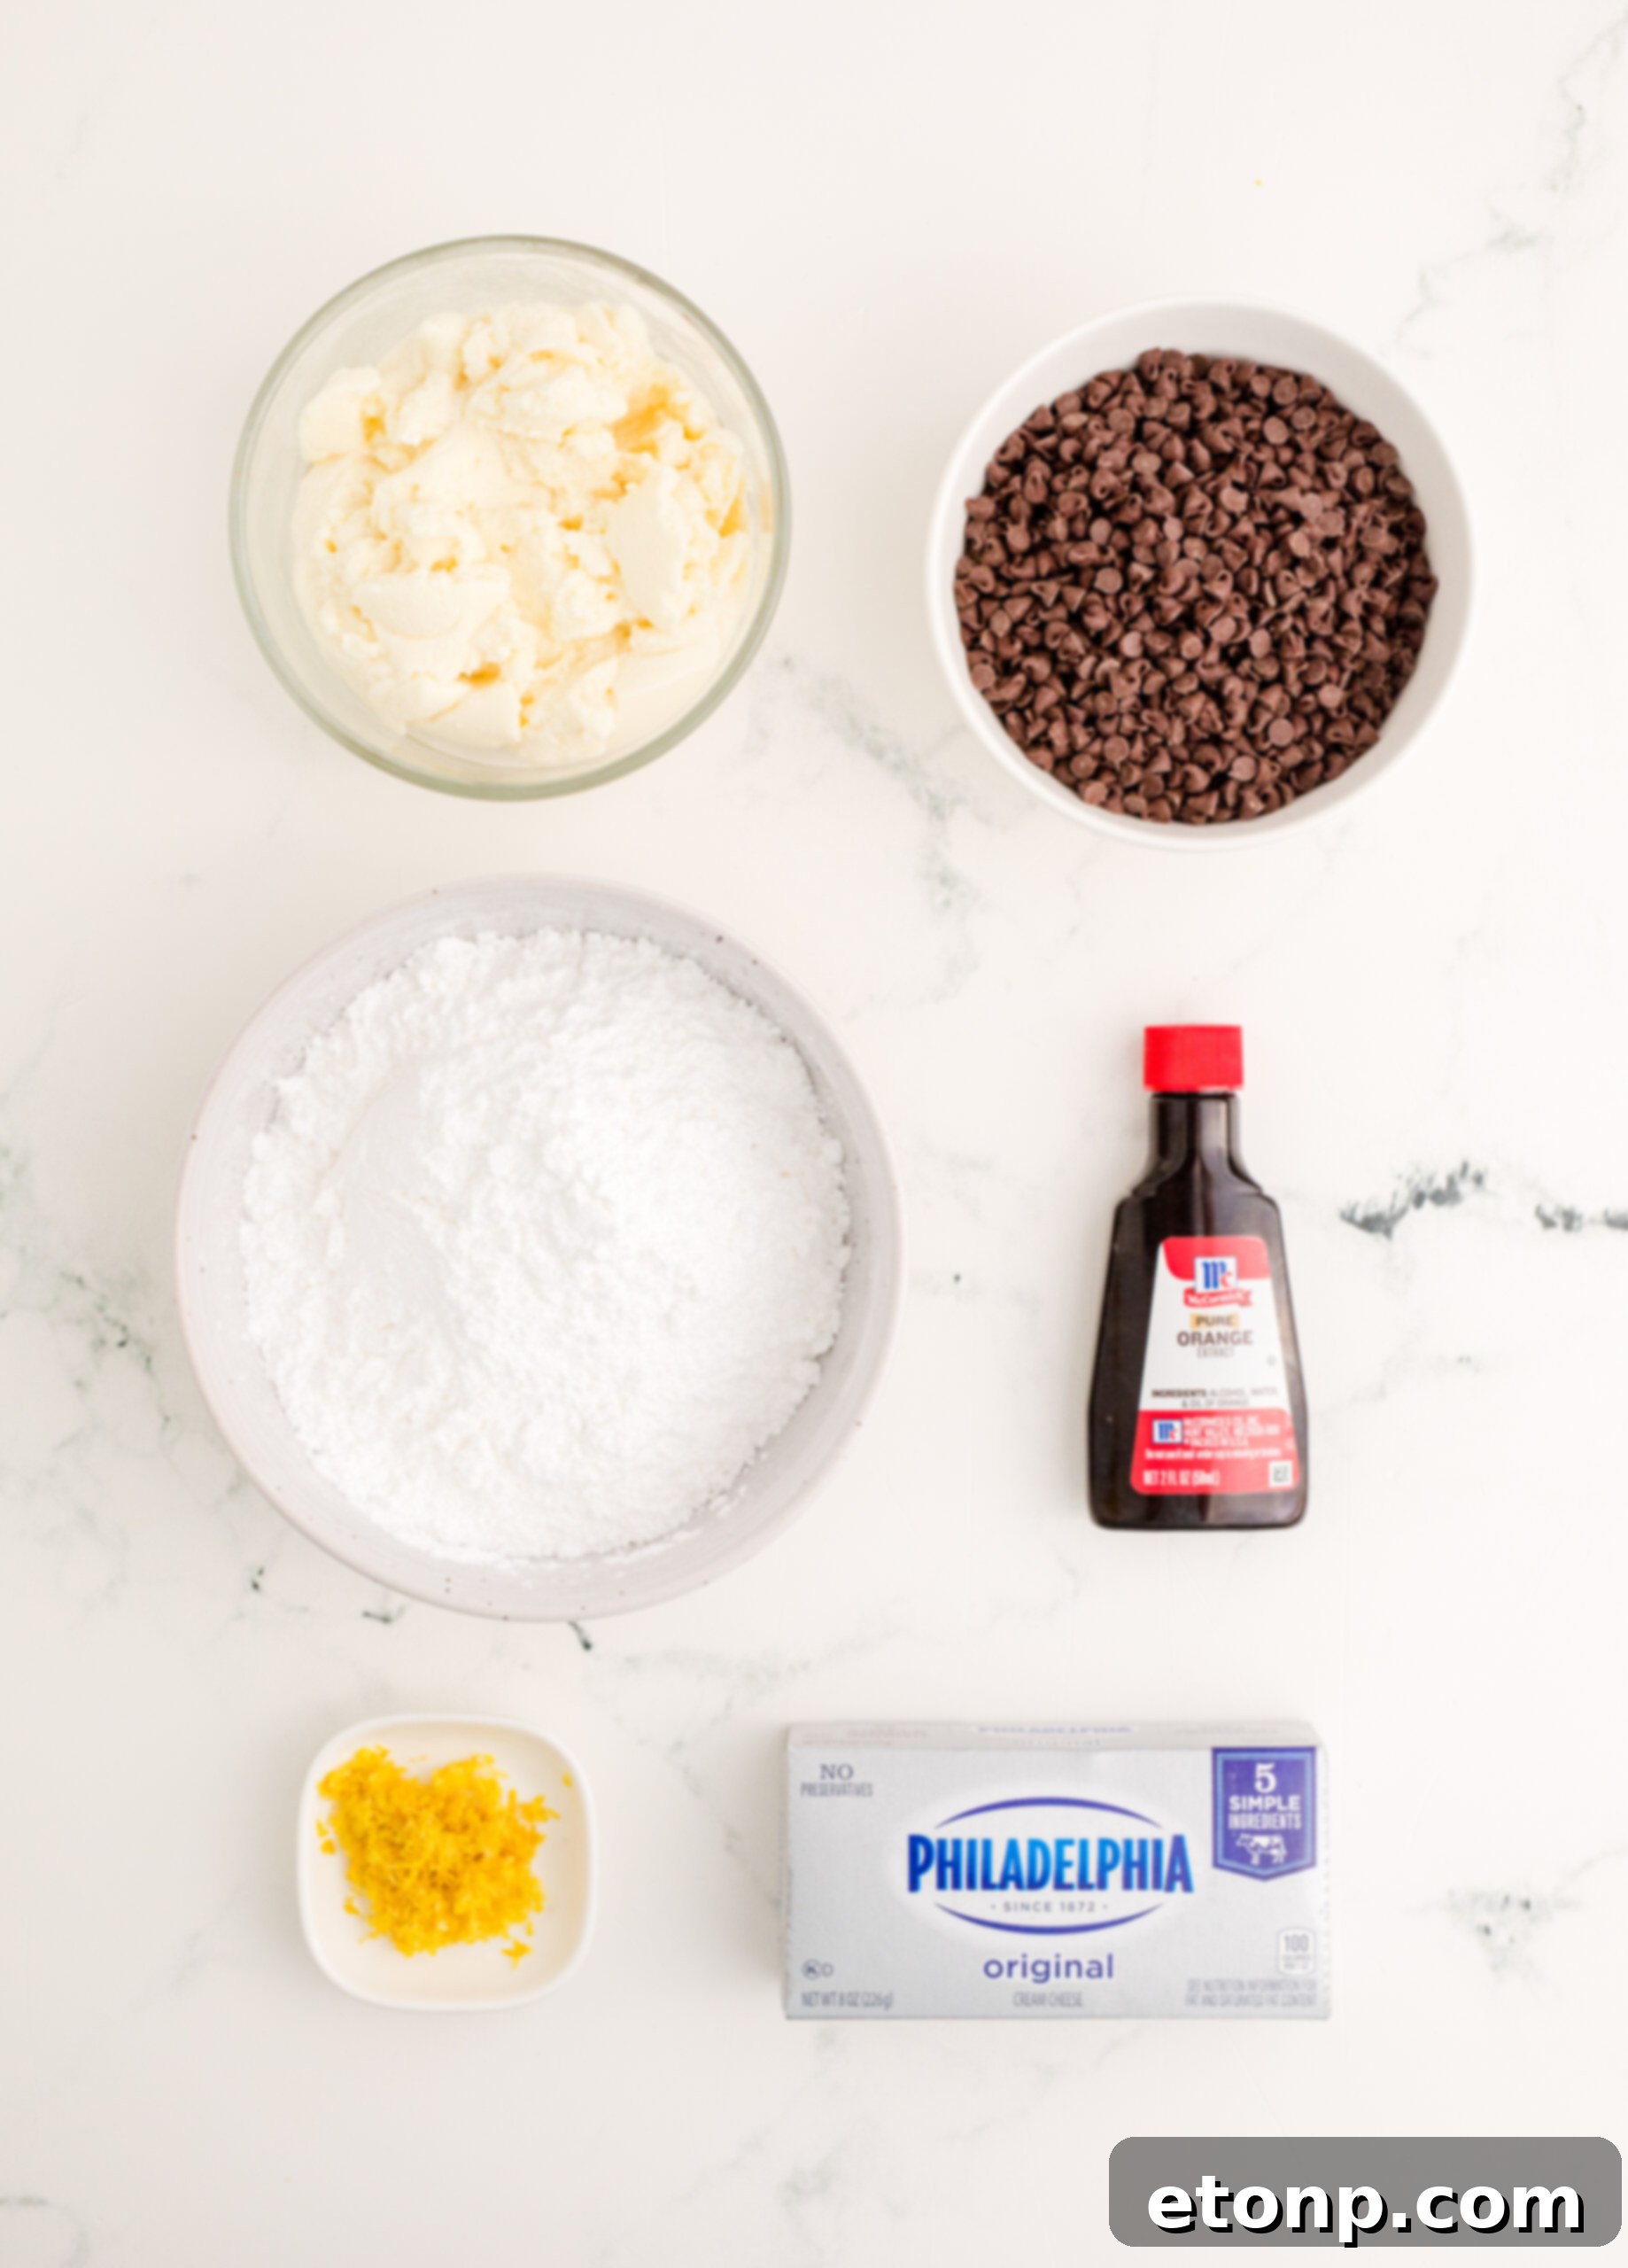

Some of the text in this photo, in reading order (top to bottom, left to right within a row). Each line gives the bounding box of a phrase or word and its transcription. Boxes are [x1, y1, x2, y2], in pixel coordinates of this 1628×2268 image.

[1196, 1317, 1233, 1327] PURE
[1177, 1331, 1253, 1347] ORANGE
[819, 1764, 854, 1780] NO
[1254, 1763, 1277, 1793] 5
[800, 1783, 873, 1797] PRESERVATIVES
[1229, 1796, 1301, 1811] SIMPLE
[1229, 1814, 1301, 1830] INGREDIENTS
[908, 1834, 1195, 1893] PHILADELPHIA
[1003, 1901, 1097, 1913] SINCE 1872
[1283, 1934, 1309, 1953] 100
[983, 1953, 1114, 1984] original
[801, 1991, 819, 2008] NET
[820, 1991, 837, 2008] WT
[847, 1991, 860, 2008] OZ
[1012, 1992, 1083, 2007] CREAM CHEESE
